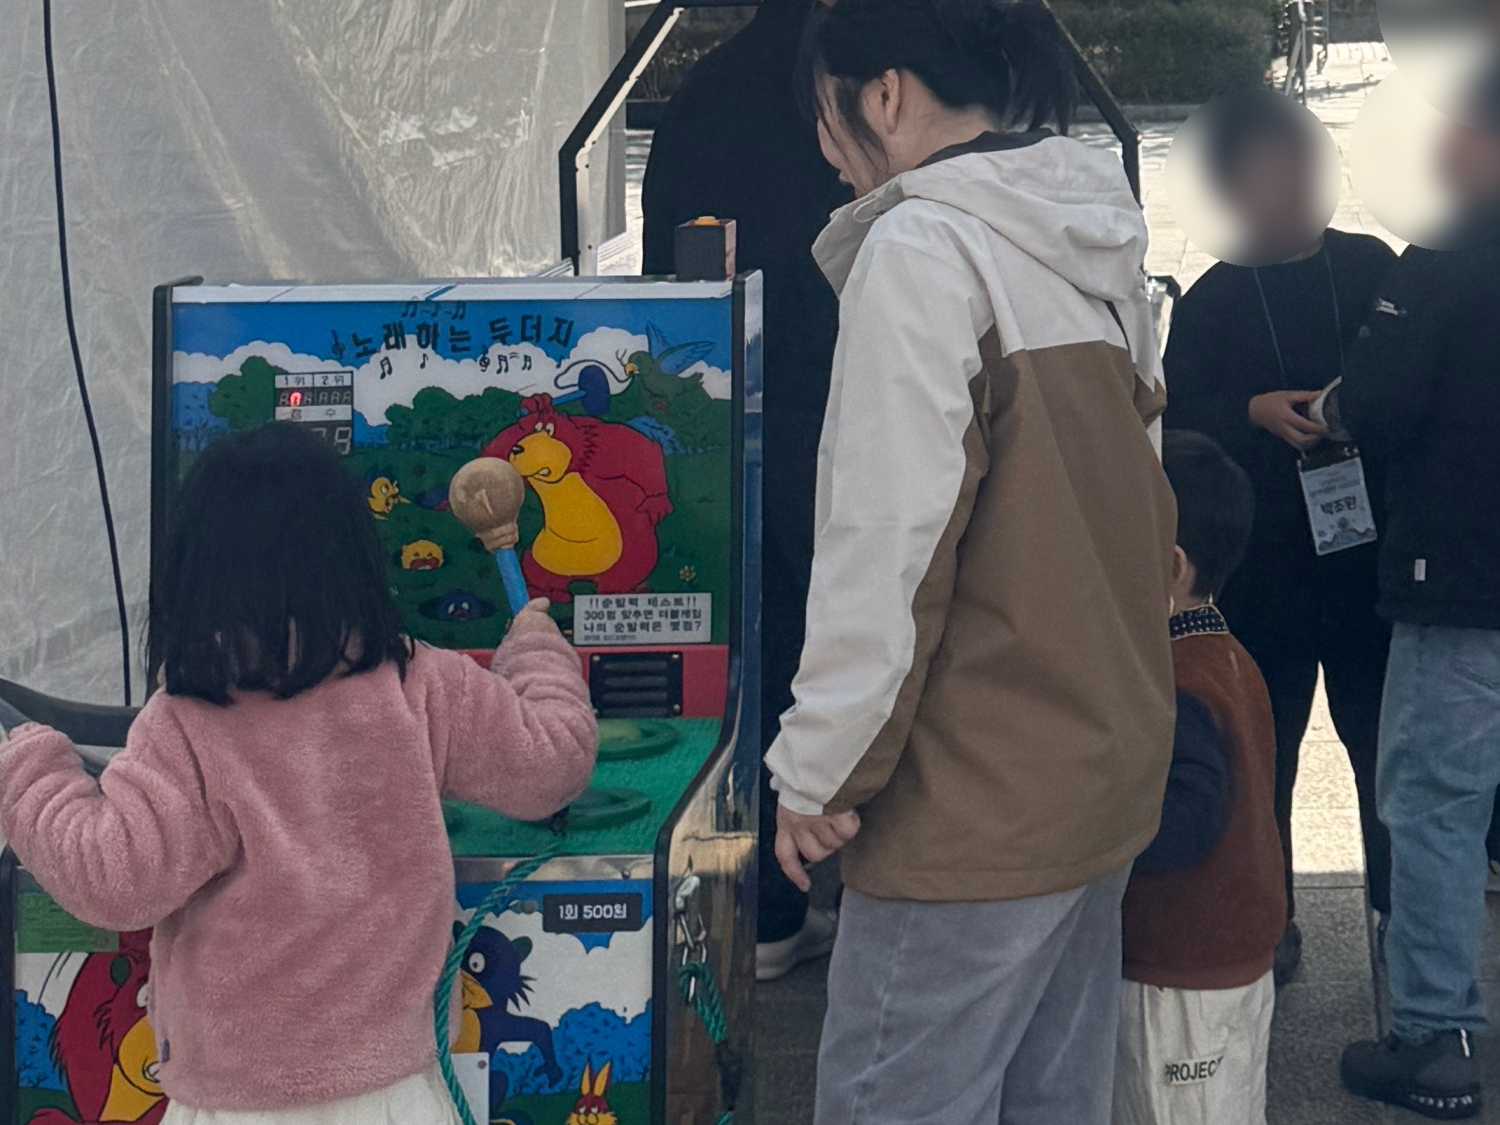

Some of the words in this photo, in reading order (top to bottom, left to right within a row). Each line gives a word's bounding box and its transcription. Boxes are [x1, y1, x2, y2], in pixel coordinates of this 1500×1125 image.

[352, 322, 472, 359] 노래하는
[489, 314, 574, 348] 두더지
[559, 904, 578, 920] 1회
[582, 903, 627, 919] 500원
